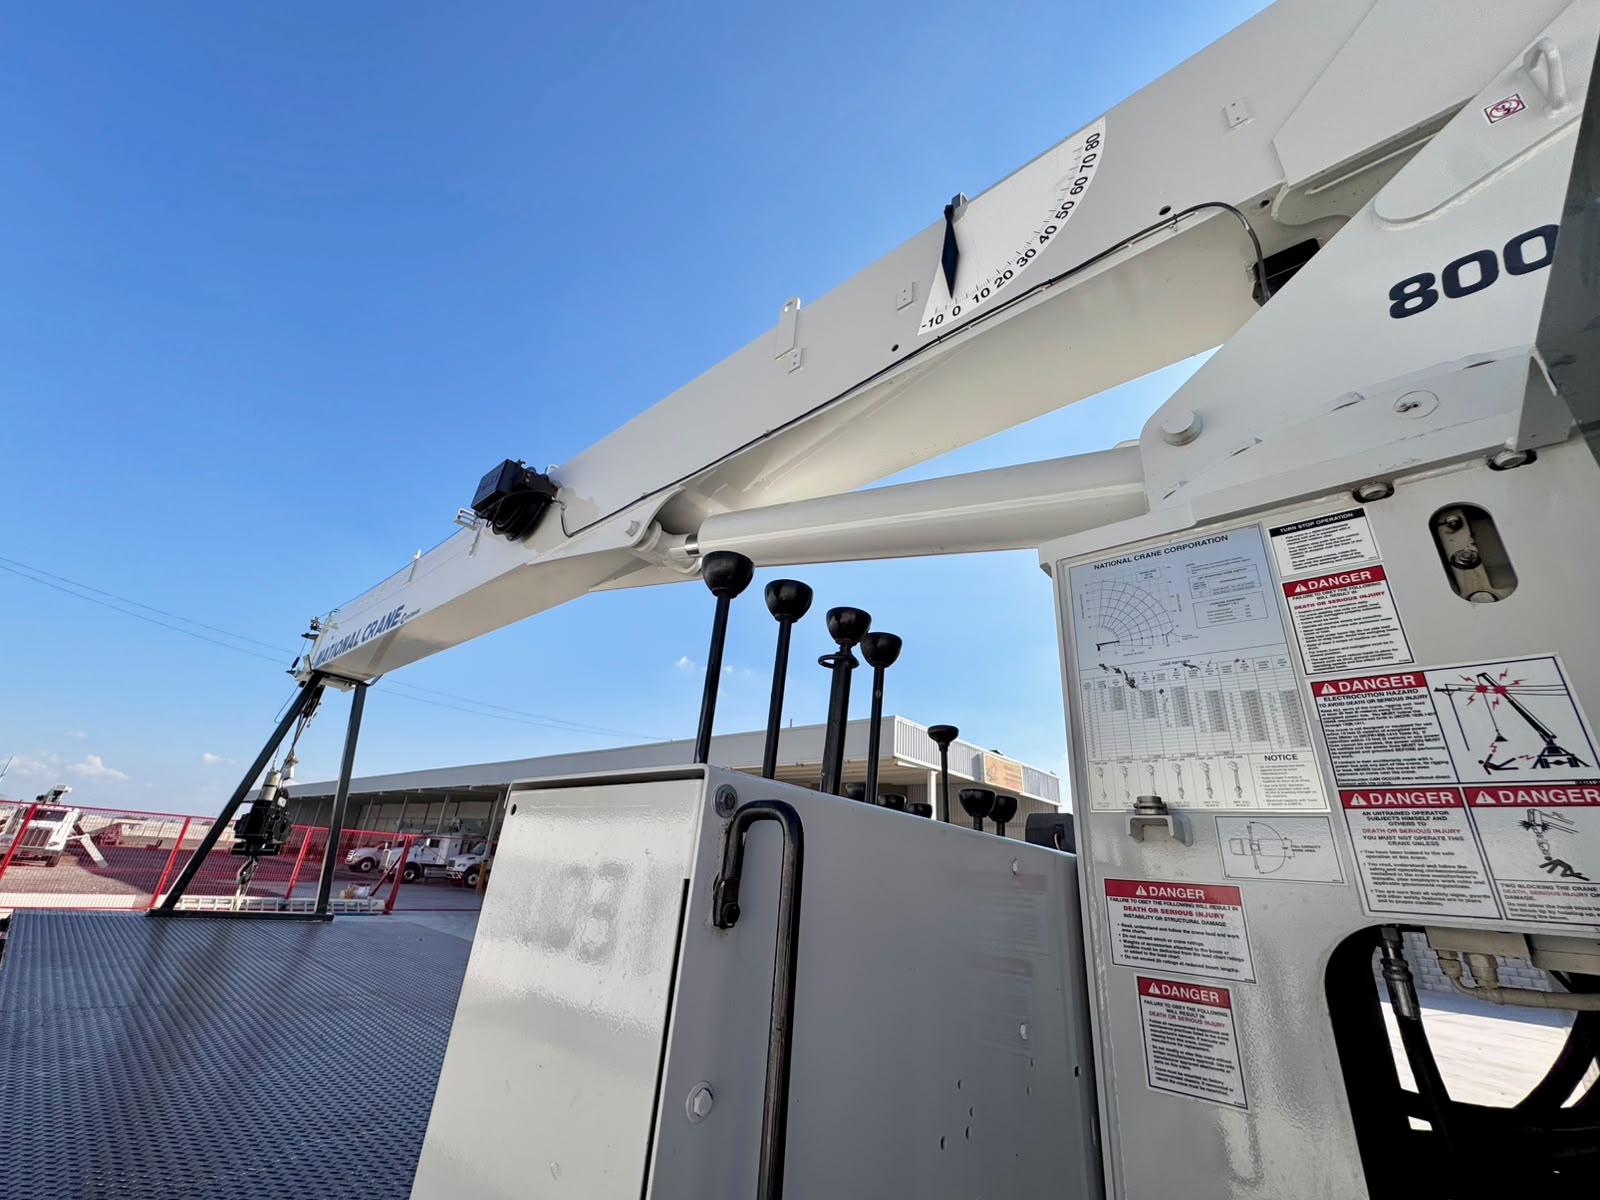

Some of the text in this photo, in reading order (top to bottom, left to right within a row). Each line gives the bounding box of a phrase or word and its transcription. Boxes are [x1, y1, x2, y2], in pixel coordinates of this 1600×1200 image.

[1085, 133, 1100, 151] 80
[1079, 154, 1096, 173] 70
[1070, 176, 1088, 195] 60
[1055, 201, 1074, 220] 50
[1039, 225, 1057, 244] 40
[1017, 248, 1036, 267] 30
[994, 270, 1013, 288] 20
[1389, 224, 1560, 319] 800
[972, 288, 990, 303] 10
[952, 306, 961, 316] 0
[921, 314, 943, 328] -10
[1315, 512, 1353, 525] OPERATION
[1094, 534, 1228, 570] NATIONAL CRANE CORPORATION
[1308, 570, 1372, 590] DANGER
[1349, 582, 1381, 590] FOLLOWING
[1328, 596, 1357, 604] SERIOUS
[320, 629, 361, 663] NATIONAL
[362, 604, 405, 642] CRANE
[1338, 675, 1416, 692] DANGER
[1324, 692, 1385, 702] ELECTROCUTION
[1264, 753, 1298, 761] NOTICE
[1369, 792, 1455, 805] DANGER
[1497, 789, 1600, 803] DANGER
[1149, 887, 1205, 899] DANGER
[1161, 984, 1219, 1003] DANGER
[1178, 1016, 1203, 1024] SERIOUS
[1197, 1008, 1228, 1017] FOLLOWING
